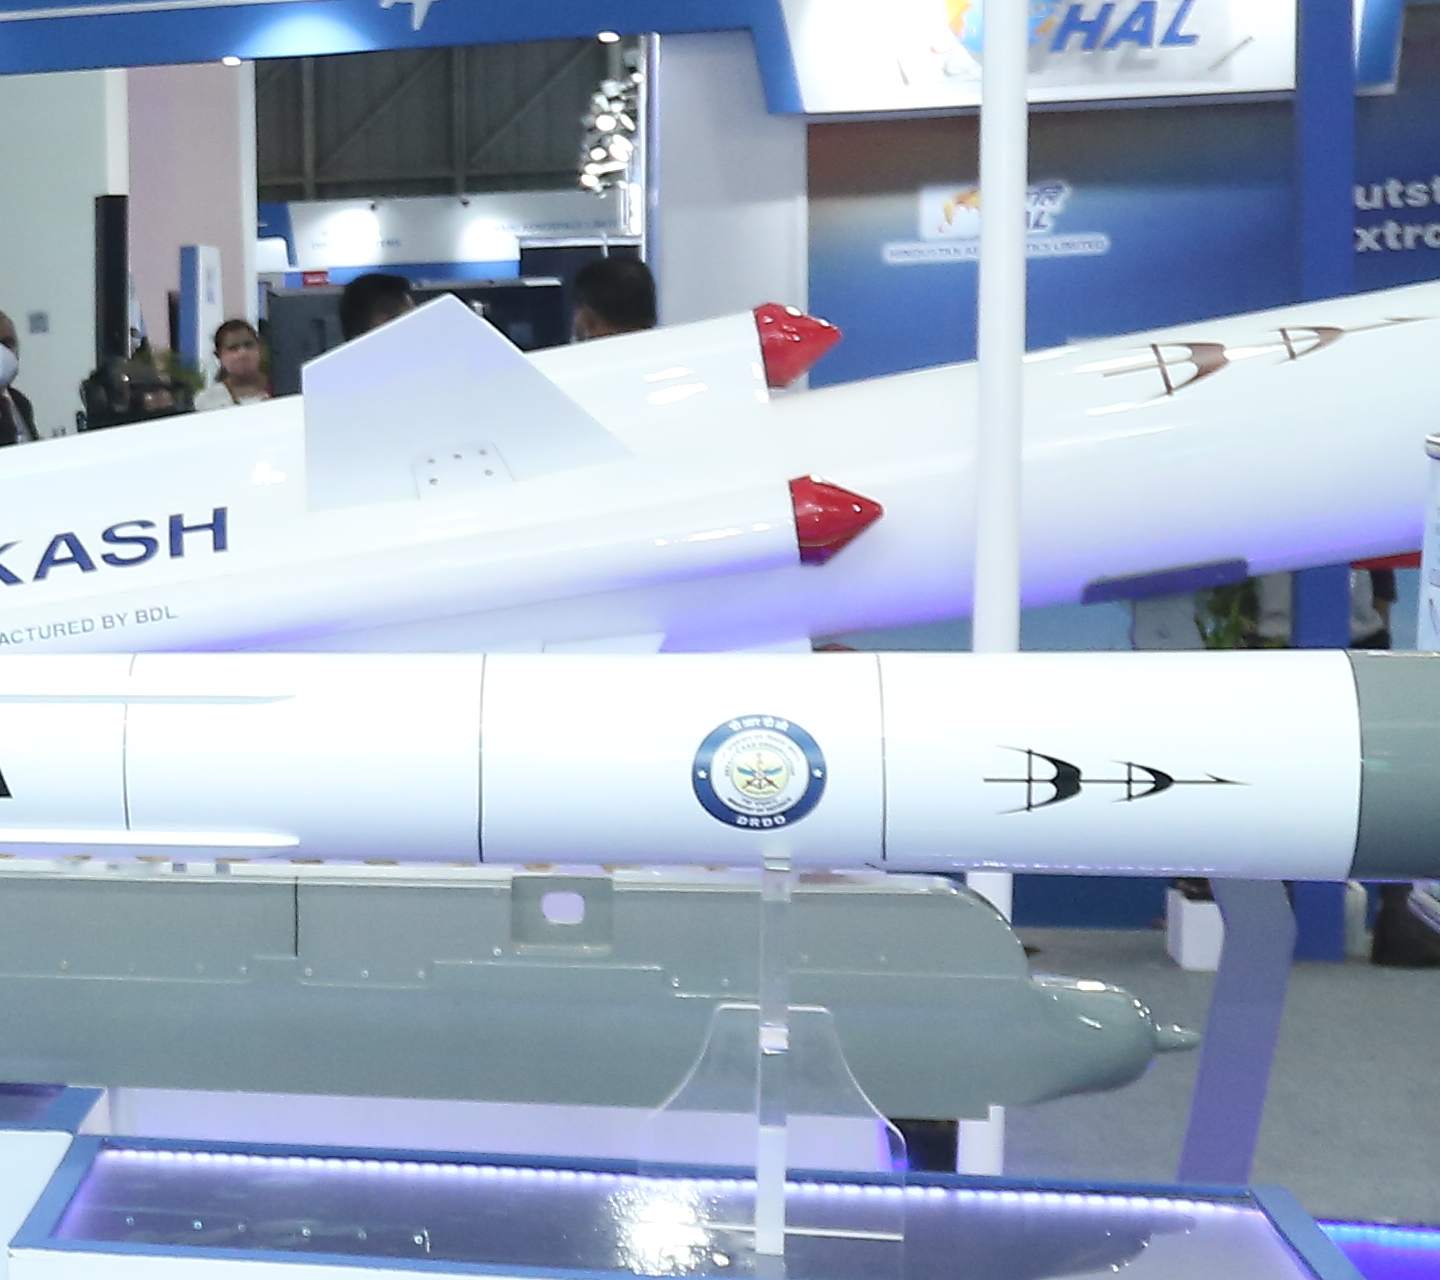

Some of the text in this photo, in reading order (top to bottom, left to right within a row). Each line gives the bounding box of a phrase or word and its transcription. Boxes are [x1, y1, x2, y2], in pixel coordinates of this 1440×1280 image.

[101, 613, 129, 630] BY
[135, 604, 179, 625] BDL
[736, 814, 787, 827] DRDO
